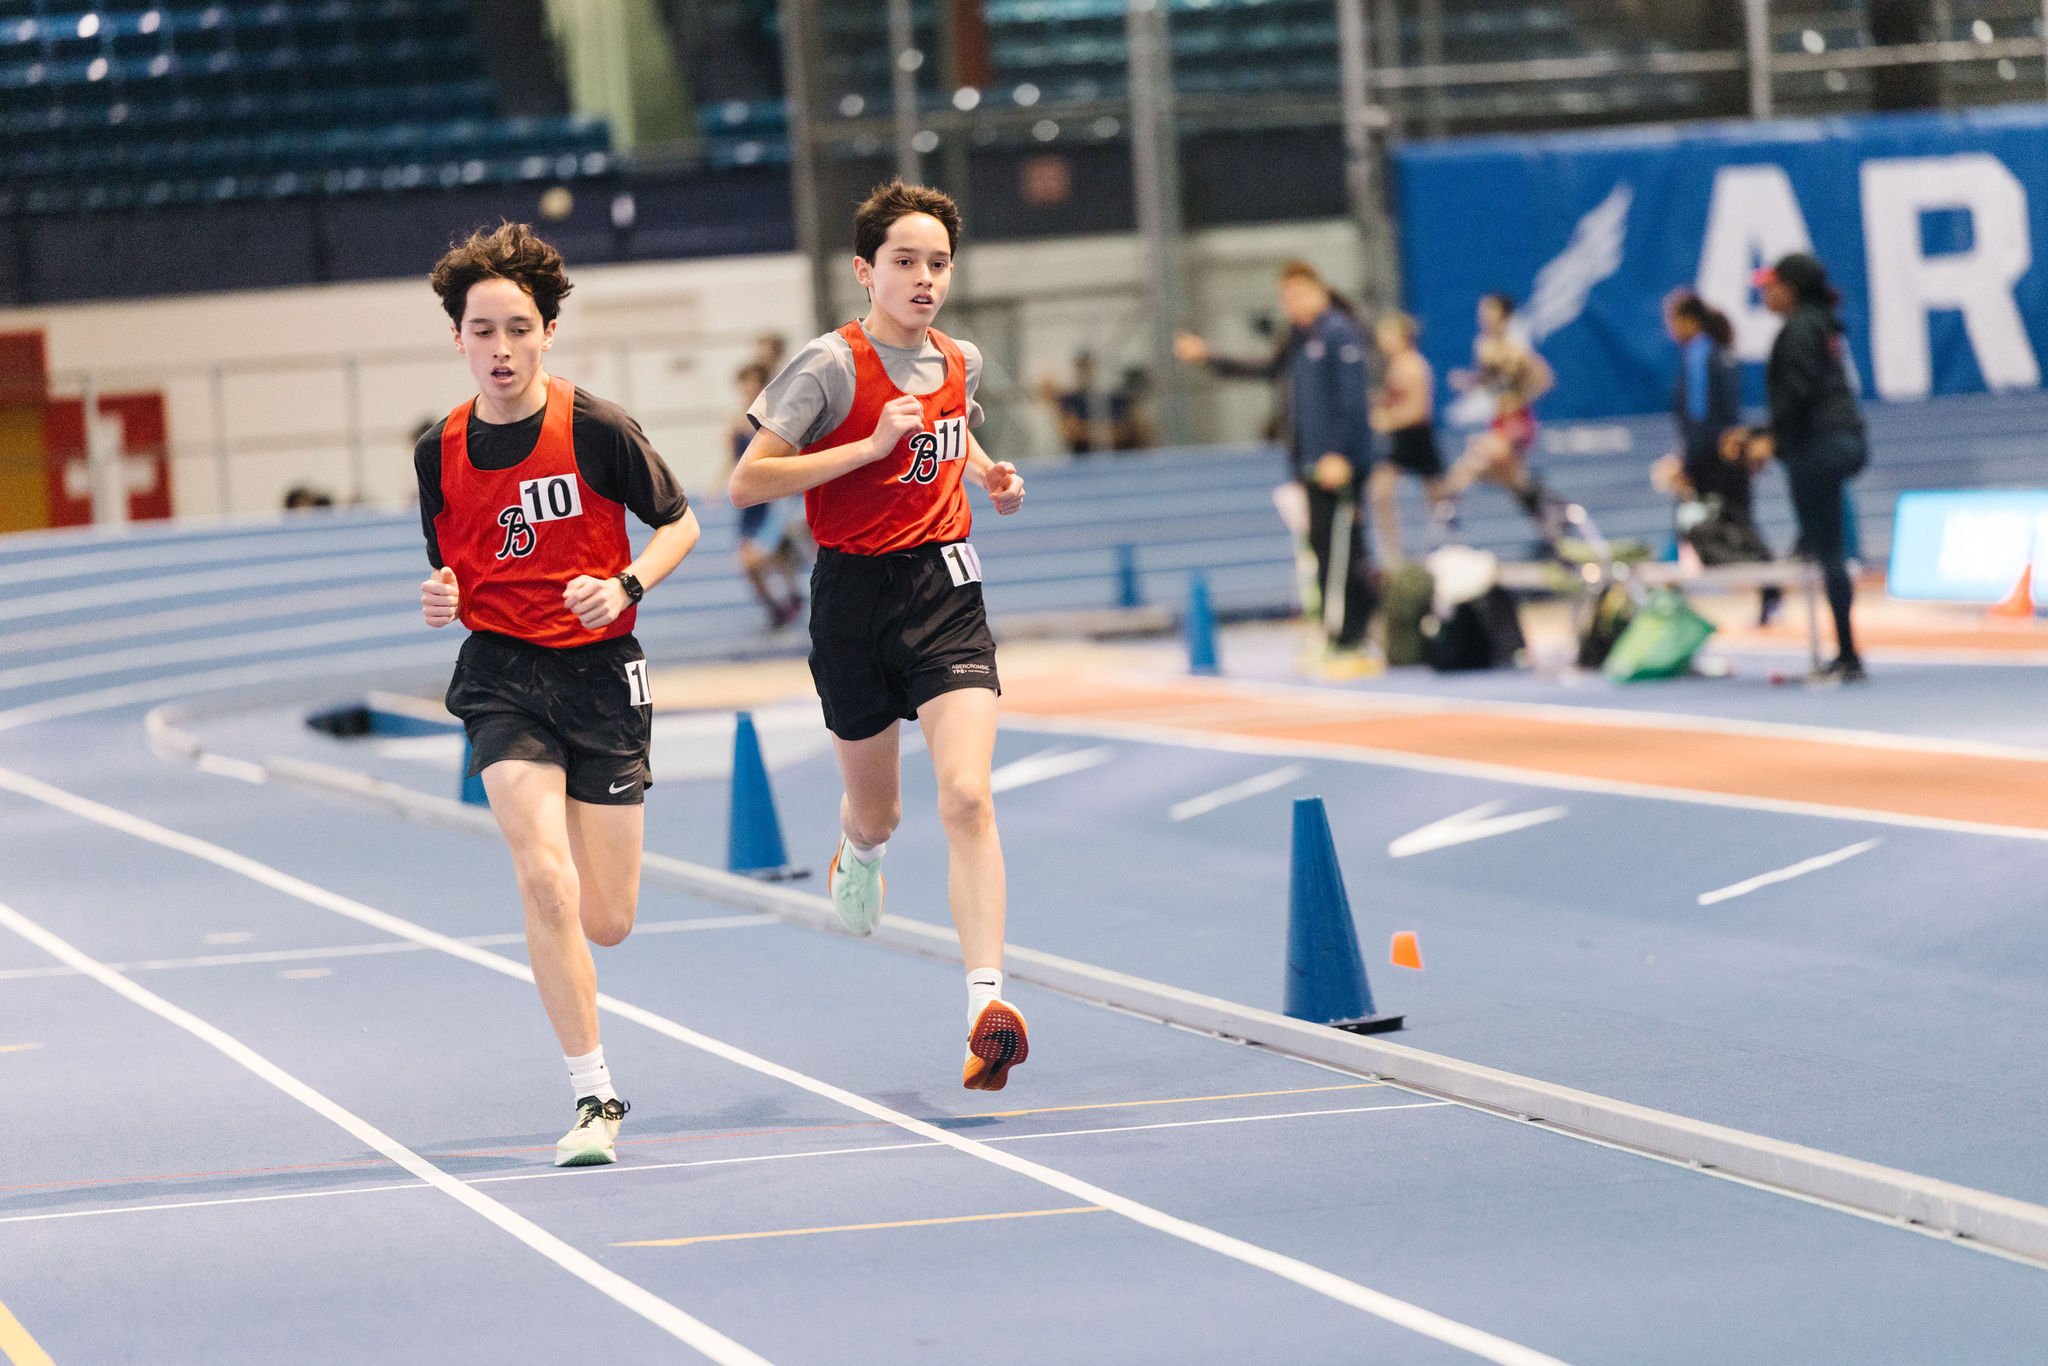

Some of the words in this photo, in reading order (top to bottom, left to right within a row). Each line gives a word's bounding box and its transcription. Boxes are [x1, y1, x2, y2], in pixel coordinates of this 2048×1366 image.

[898, 432, 939, 484] B
[938, 419, 961, 460] 11
[524, 478, 572, 520] 10
[496, 505, 536, 560] B
[631, 663, 651, 703] 1
